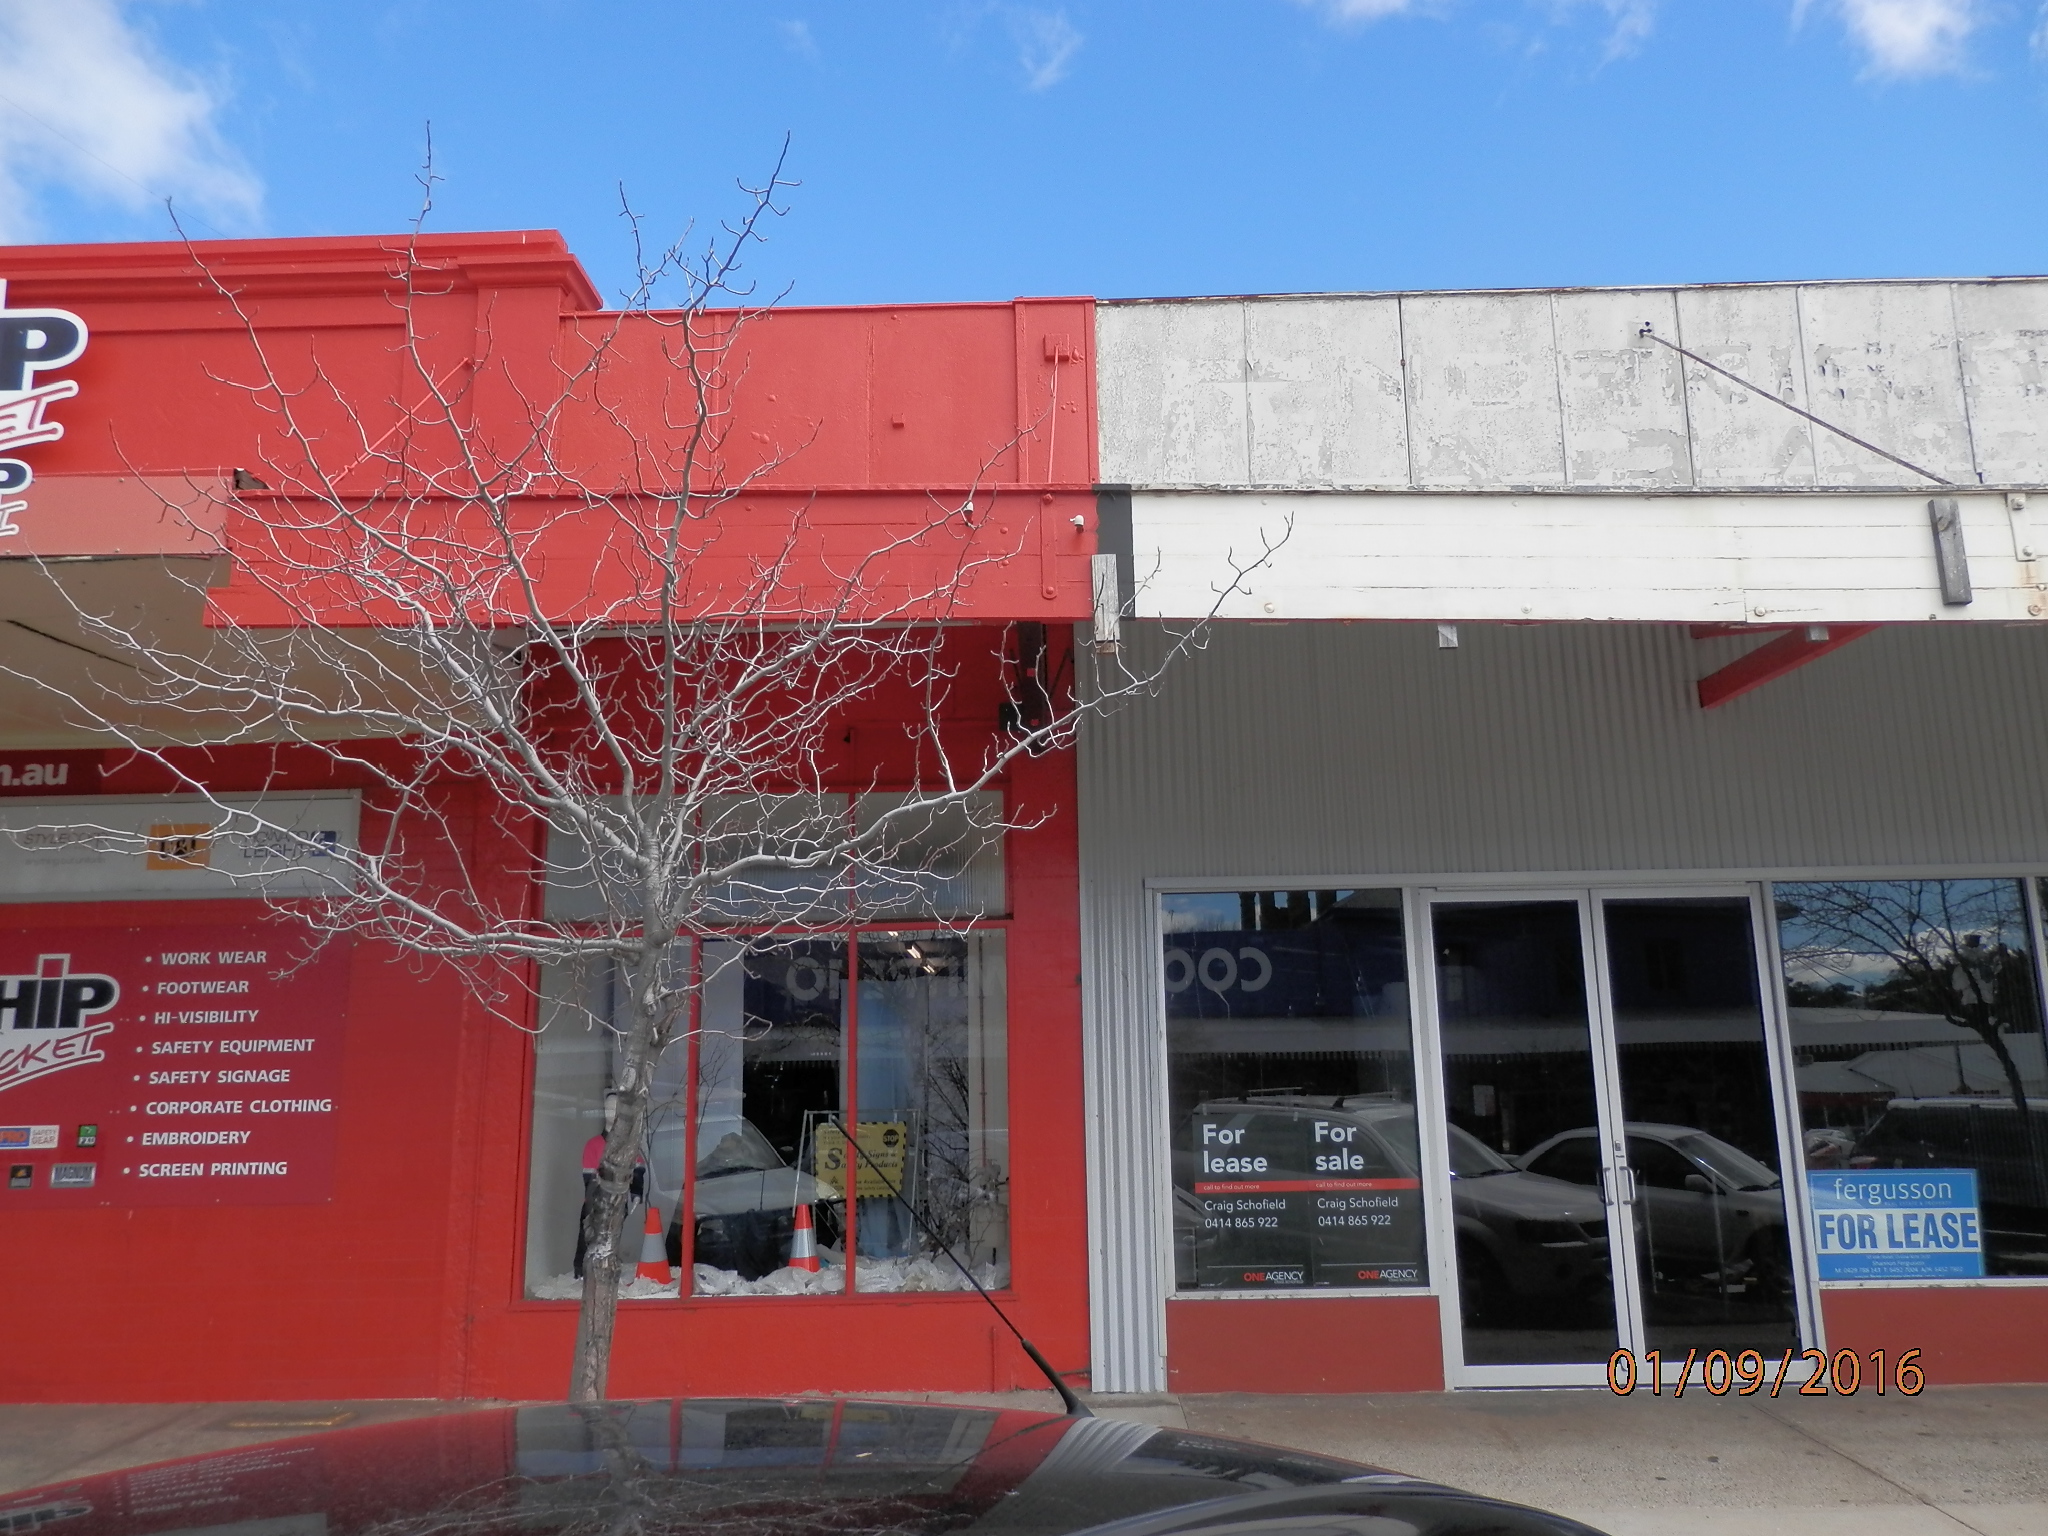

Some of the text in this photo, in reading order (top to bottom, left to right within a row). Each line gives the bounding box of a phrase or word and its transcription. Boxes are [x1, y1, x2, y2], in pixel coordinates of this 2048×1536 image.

[161, 951, 267, 965] WORK WEAR
[157, 980, 249, 995] FOOTWEAR
[154, 1009, 259, 1025] HI-VISIBILITY
[151, 1038, 315, 1056] SAFETY EQUIPMENT
[149, 1069, 291, 1085] SAFETY SIGNAGE
[146, 1099, 332, 1115] CORPORATE CLOTHING
[142, 1130, 251, 1146] EMBROIDERY
[1203, 1123, 1246, 1145] For
[1314, 1121, 1357, 1143] For
[865, 1160, 898, 1168] Poducts
[1203, 1150, 1268, 1173] lease
[1315, 1147, 1364, 1171] sale
[139, 1161, 288, 1177] SCREEN PRINTING
[1834, 1178, 1952, 1205] fergusson
[1204, 1198, 1286, 1213] Craig Schofield
[1317, 1196, 1399, 1212] Craig Schofield
[1205, 1216, 1278, 1228] 0414 865 922
[1318, 1214, 1391, 1226] 0414 865 922
[1819, 1212, 1979, 1250] FOR LEASE
